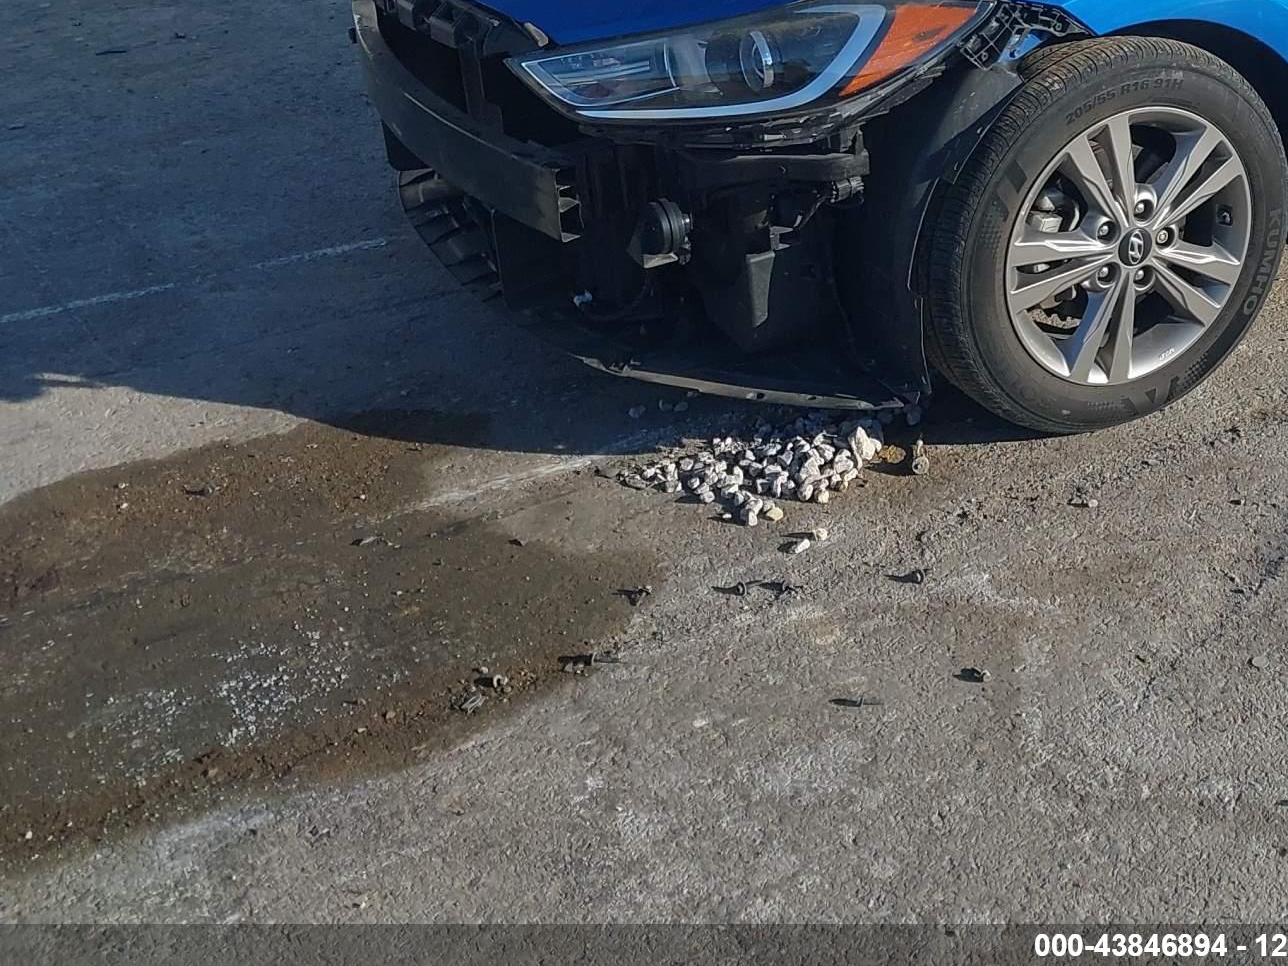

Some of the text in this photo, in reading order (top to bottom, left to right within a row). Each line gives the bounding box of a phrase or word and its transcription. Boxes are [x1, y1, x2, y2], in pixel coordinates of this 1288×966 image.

[1065, 77, 1185, 126] 205/55 R16 91H
[1244, 209, 1281, 315] KUMHO
